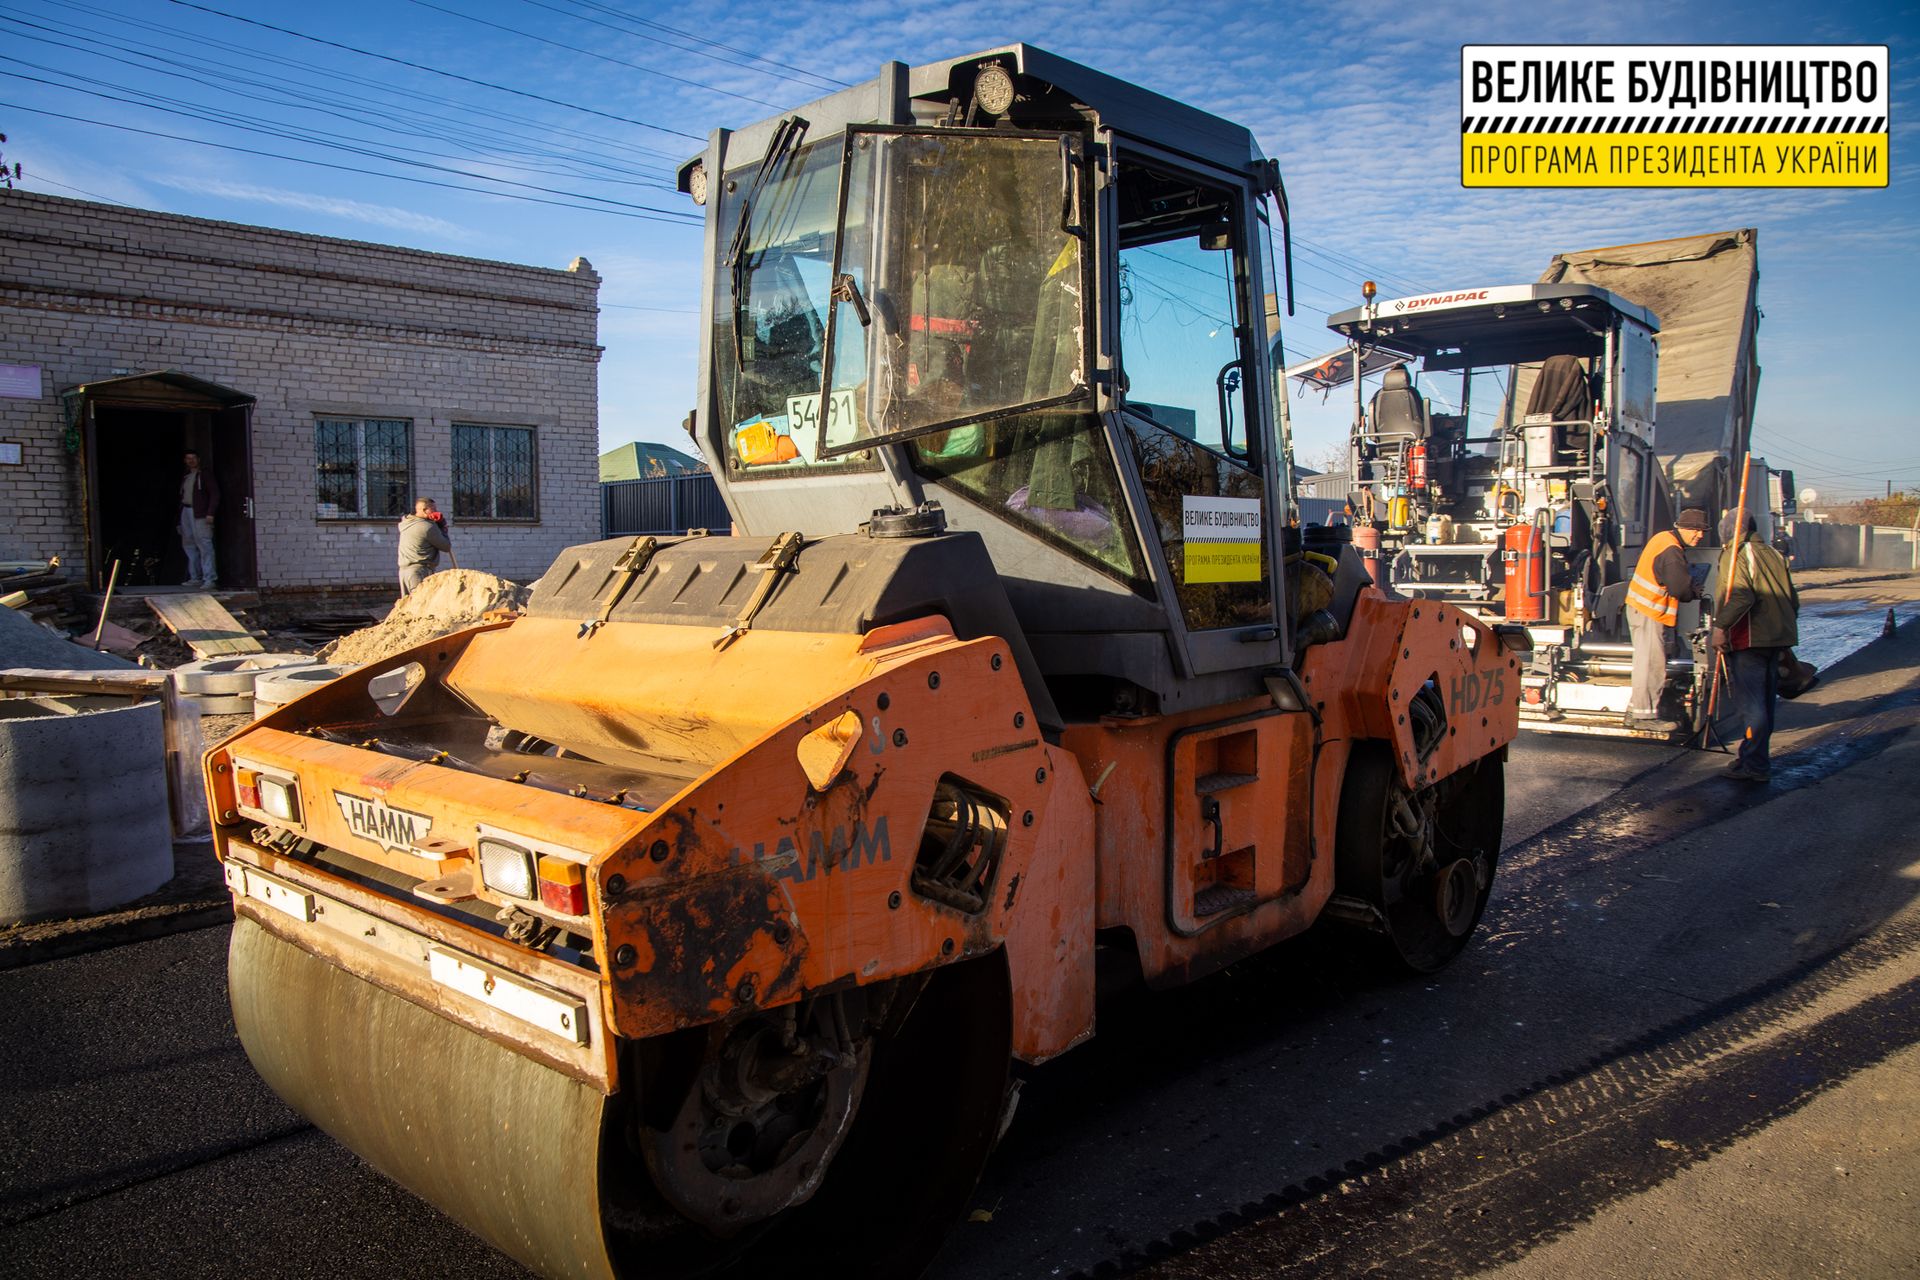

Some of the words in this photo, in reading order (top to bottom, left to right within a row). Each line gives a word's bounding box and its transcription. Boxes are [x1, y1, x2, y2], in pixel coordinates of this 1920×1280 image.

[1407, 291, 1489, 309] DYNAPAC
[792, 394, 852, 430] 5491
[1184, 510, 1213, 526] ВЕЛИКЕ
[1214, 511, 1260, 528] БУДІВНИЦТВО
[349, 799, 417, 846] HAMM
